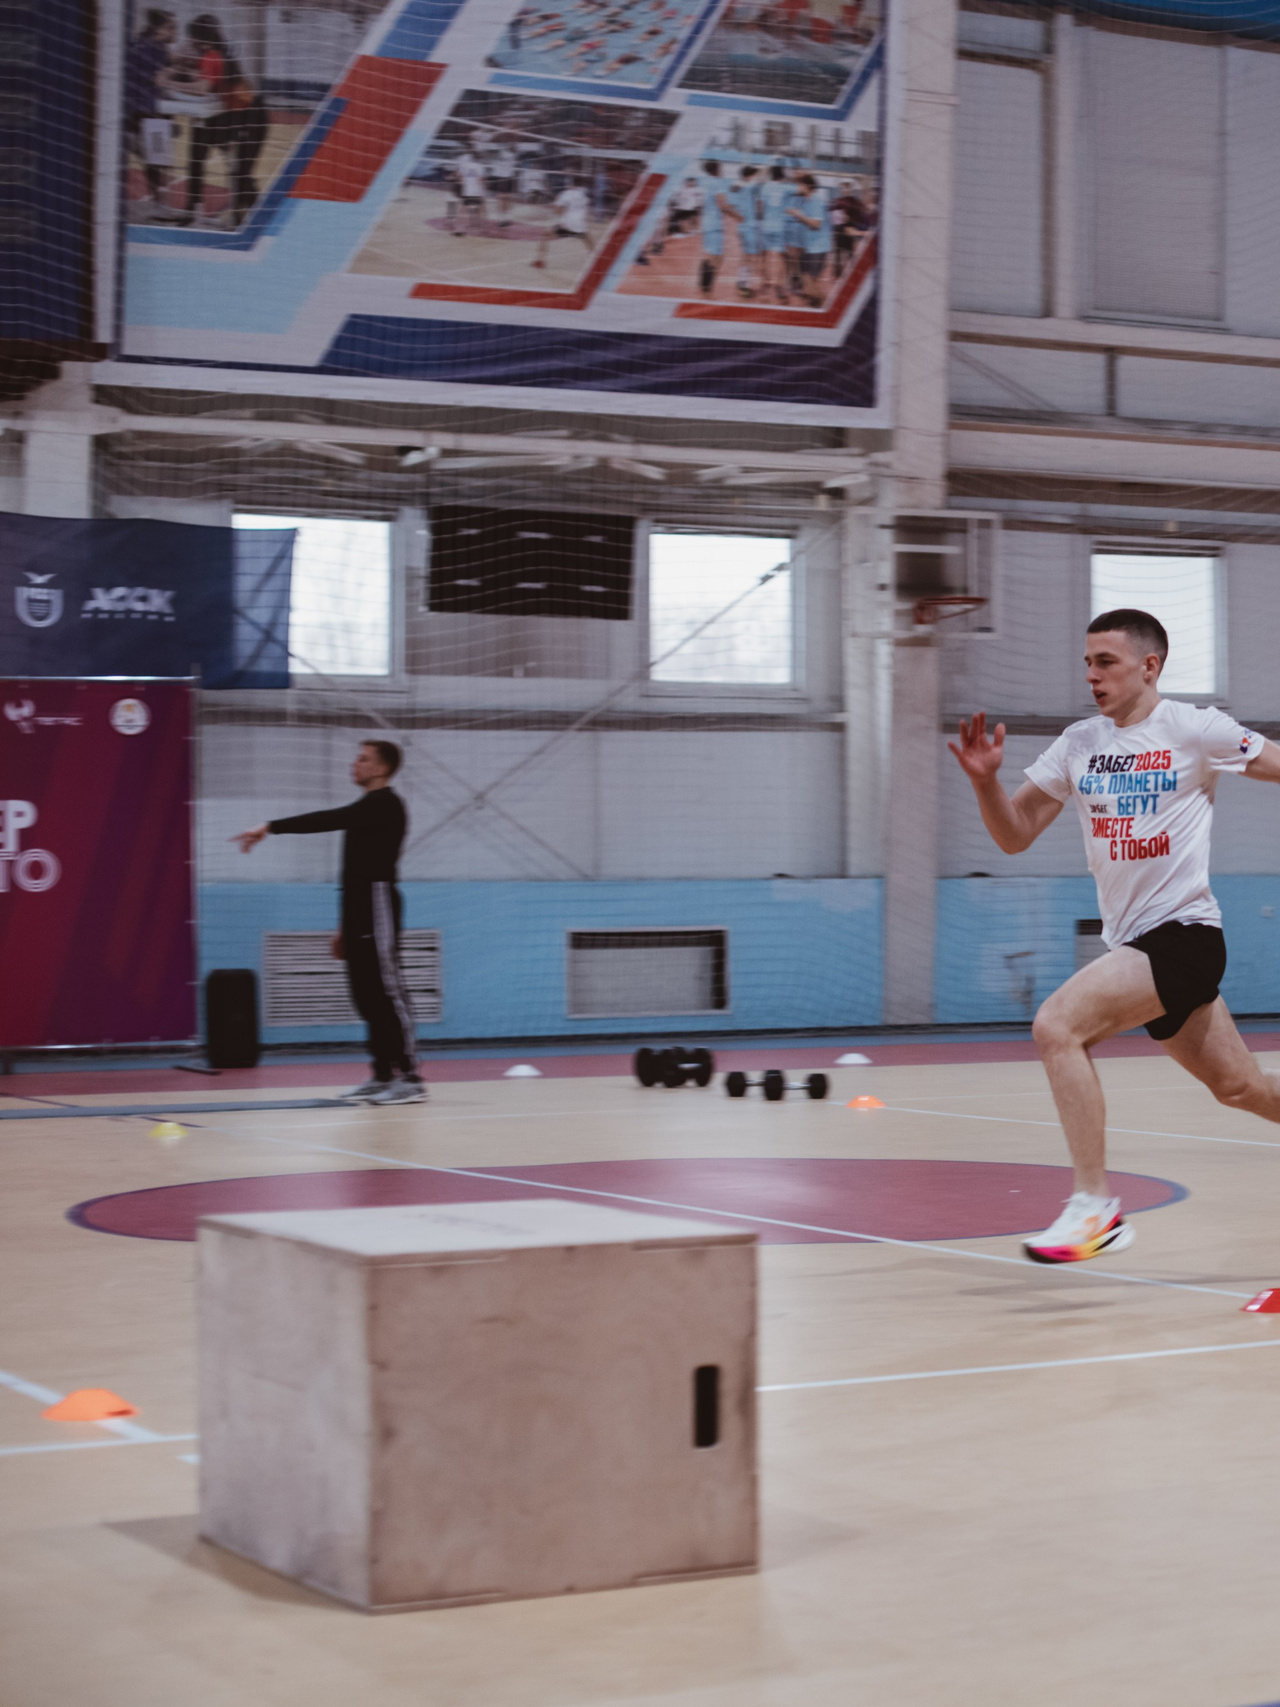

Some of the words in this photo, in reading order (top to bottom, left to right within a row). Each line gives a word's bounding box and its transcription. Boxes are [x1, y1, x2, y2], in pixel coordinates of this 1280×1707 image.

[1078, 774, 1105, 795] 45%
[1107, 771, 1177, 794] ПЛАНЕТЫ
[1117, 794, 1159, 816] БЕГУТ
[1110, 839, 1118, 861] С
[1120, 831, 1170, 861] ТОБОЙ
